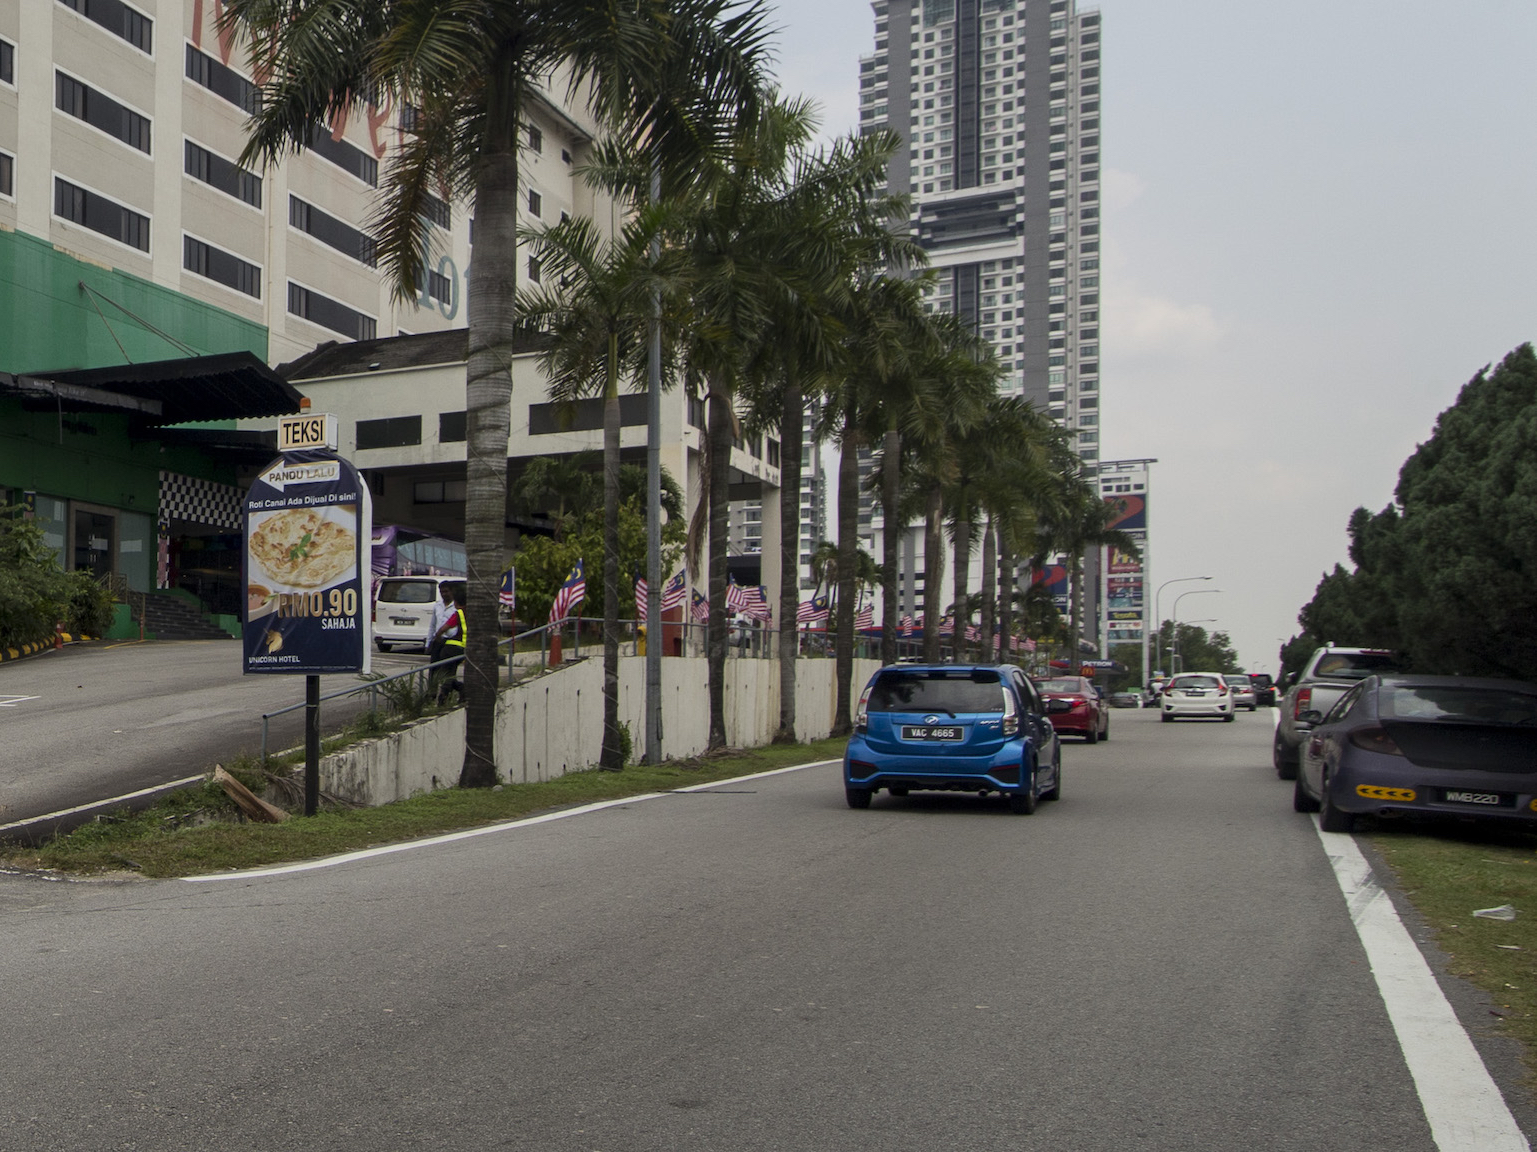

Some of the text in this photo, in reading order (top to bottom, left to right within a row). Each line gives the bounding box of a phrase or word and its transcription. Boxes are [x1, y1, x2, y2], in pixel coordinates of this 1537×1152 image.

[283, 420, 323, 444] TEKSI
[269, 467, 335, 482] PANDU LALU
[248, 500, 263, 509] Roti
[288, 497, 302, 505] Ada
[304, 494, 327, 505] Dijual
[328, 493, 337, 502] Di
[339, 493, 356, 501] sini!
[278, 588, 357, 618] RM0.90
[321, 618, 356, 630] SAHAJA
[248, 655, 300, 664] UNICORN HOTEL
[911, 729, 954, 737] VAC 4665
